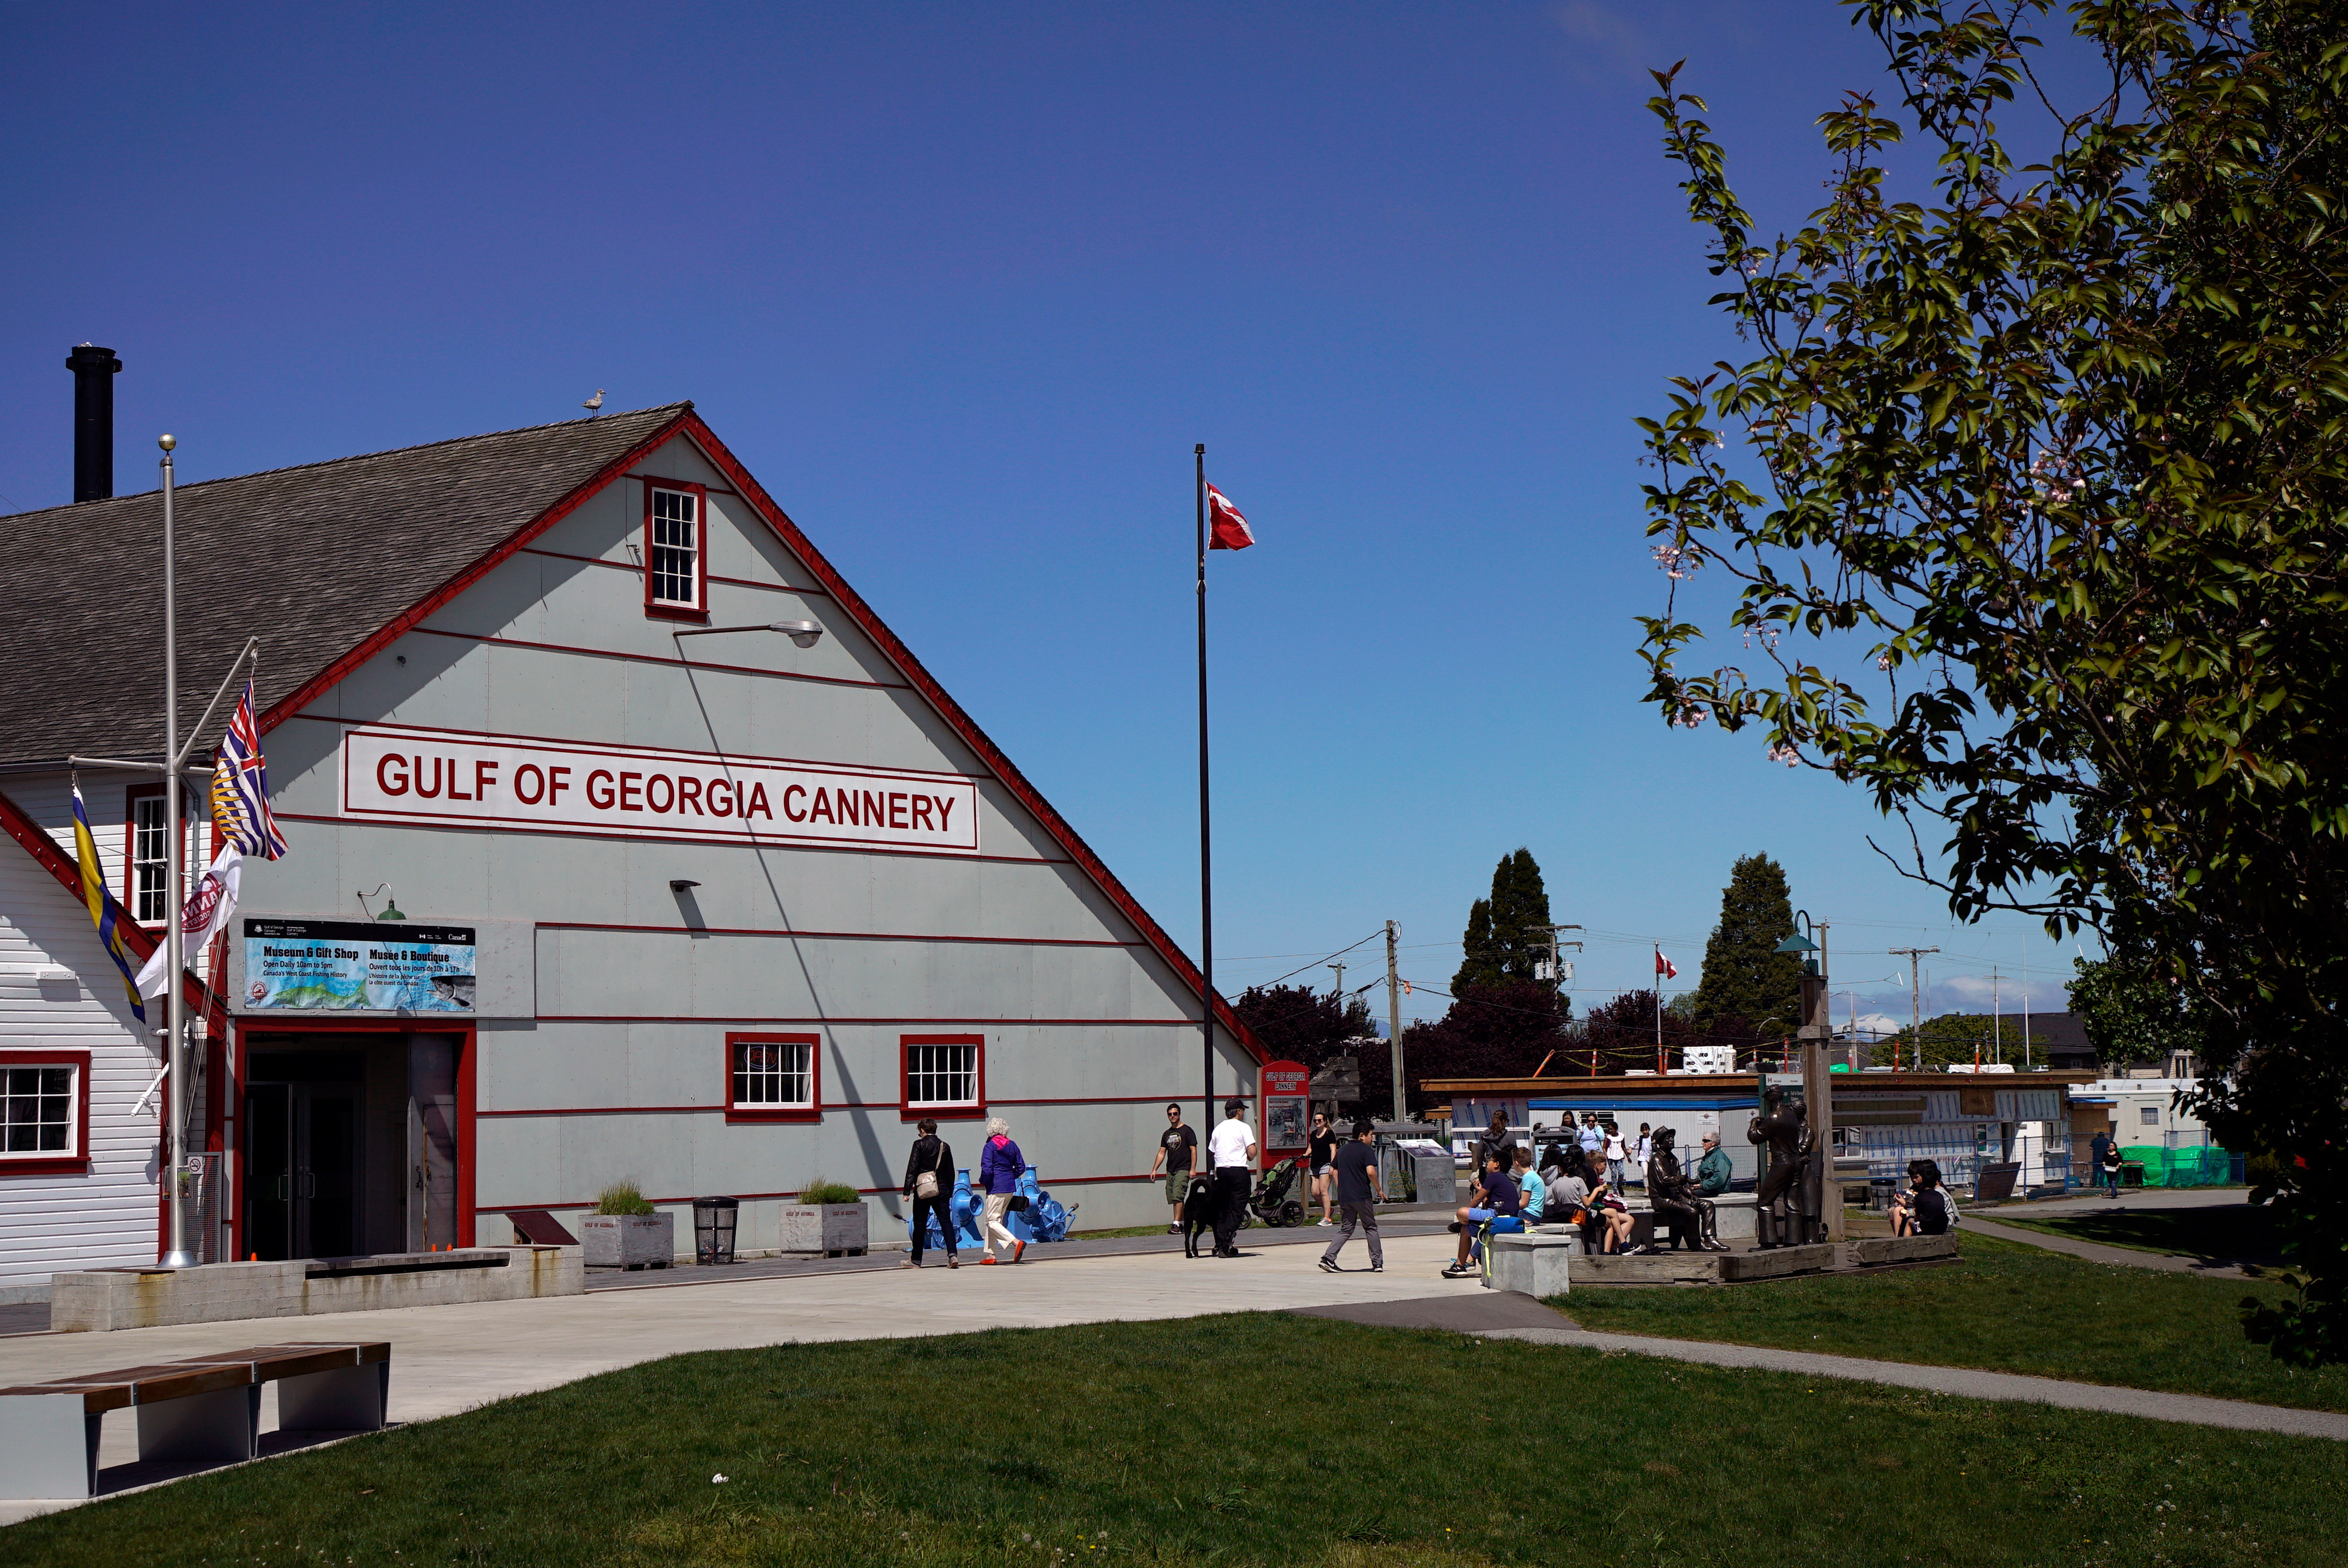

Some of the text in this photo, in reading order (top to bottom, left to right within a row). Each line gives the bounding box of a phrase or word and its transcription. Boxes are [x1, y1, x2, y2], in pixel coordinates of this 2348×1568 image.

[377, 754, 955, 831] GULF OF GEORGIA CANNERY
[264, 946, 359, 961] Museum & Gift Shop
[369, 949, 449, 964] Musée & Boutique
[280, 960, 294, 969] Daily
[321, 962, 333, 970] 5pm
[1266, 1072, 1306, 1081] GULF OF GEORGIA
[1275, 1082, 1297, 1091] CANNERY
